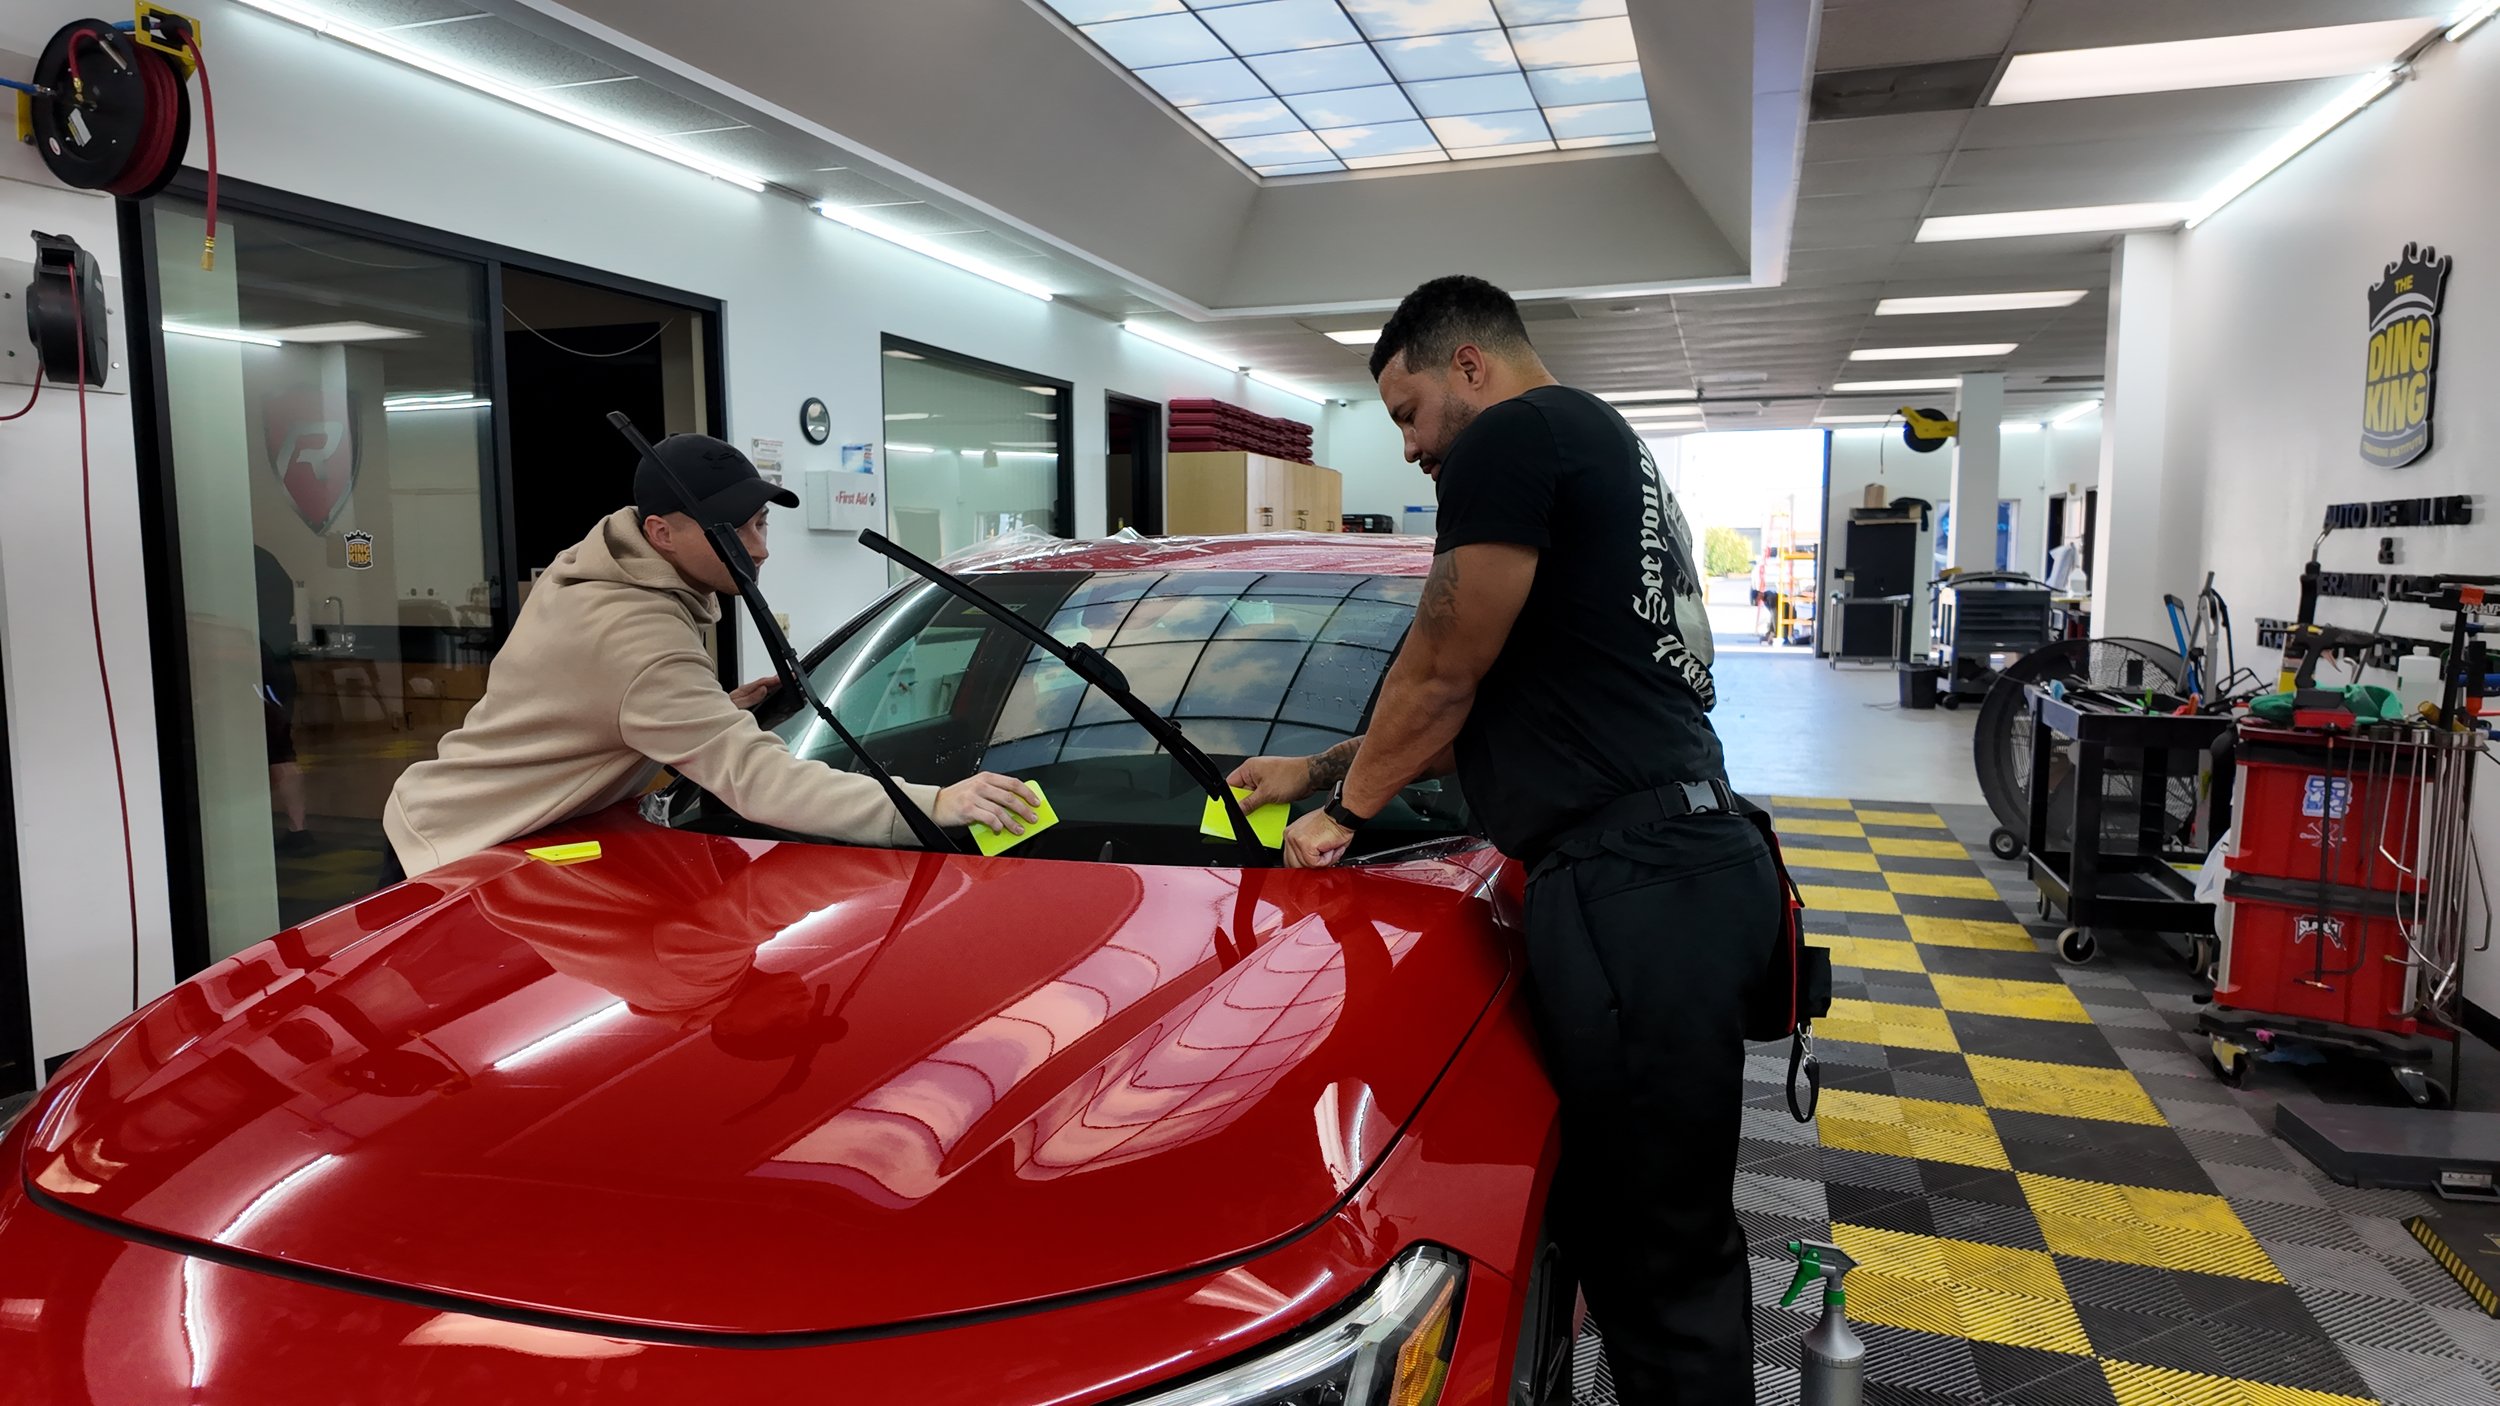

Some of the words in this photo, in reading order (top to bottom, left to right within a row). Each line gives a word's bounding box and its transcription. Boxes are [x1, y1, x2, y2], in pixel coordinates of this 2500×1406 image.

[2394, 274, 2414, 294] THE
[2368, 318, 2431, 382] DING
[2364, 372, 2427, 432] KING
[839, 491, 855, 504] First
[856, 492, 868, 505] Aid
[1640, 484, 1668, 552] you
[2323, 502, 2368, 530] AUTO
[349, 543, 370, 554] DING
[350, 553, 370, 564] KING
[2378, 537, 2394, 565] &
[1632, 556, 1670, 626] See
[2317, 571, 2386, 600] ERAMIC
